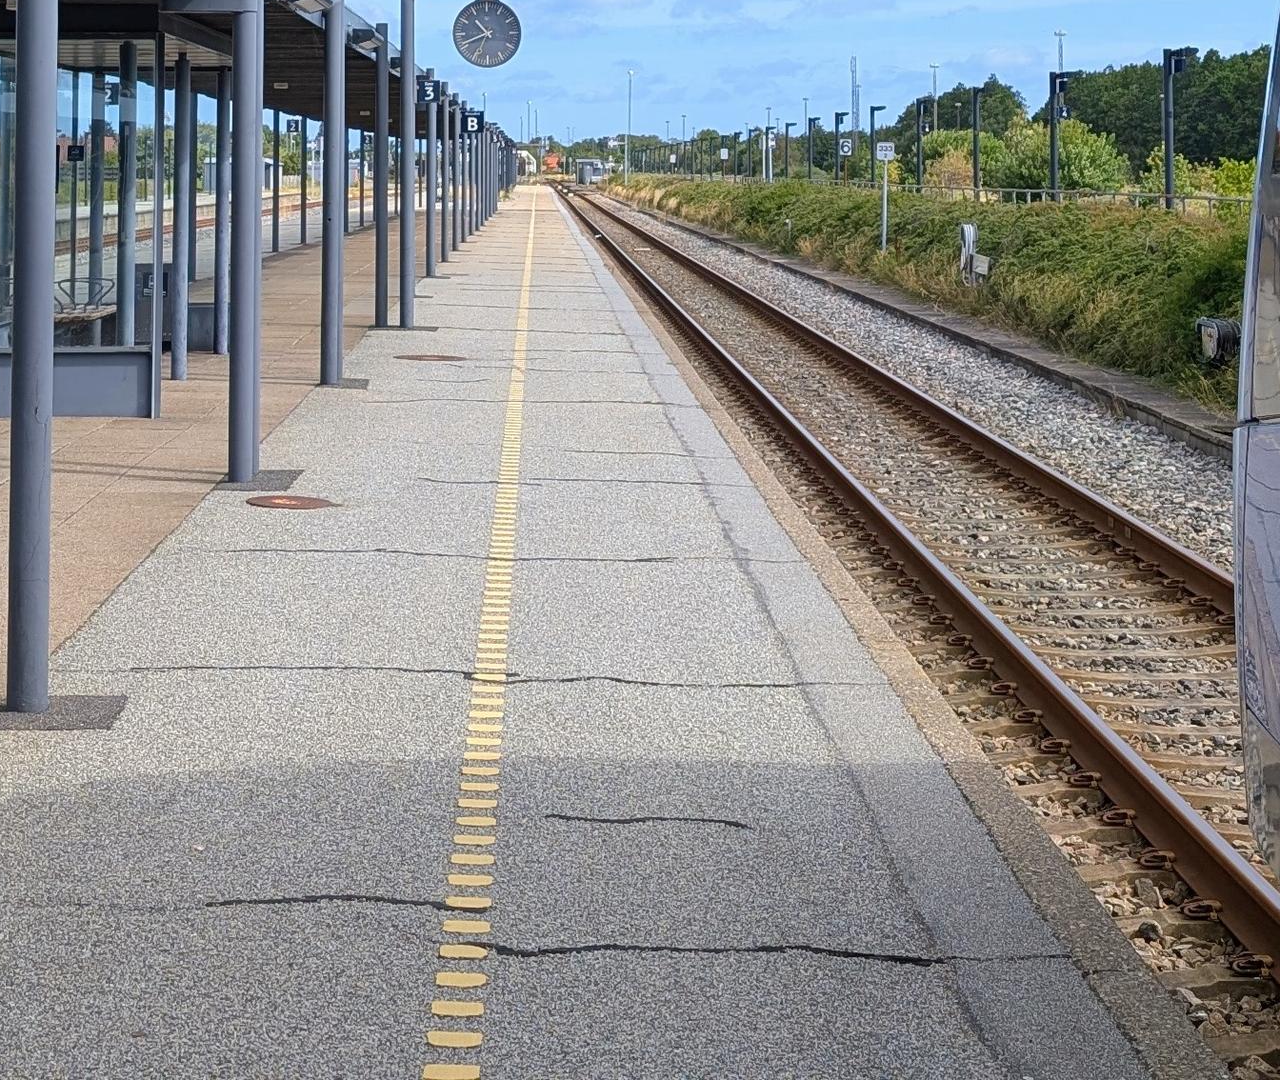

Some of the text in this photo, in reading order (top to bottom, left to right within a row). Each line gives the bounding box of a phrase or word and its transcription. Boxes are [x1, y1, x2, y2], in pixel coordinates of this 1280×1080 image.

[424, 86, 434, 101] 3
[290, 123, 296, 132] 2
[467, 117, 479, 131] B
[840, 140, 851, 154] 6
